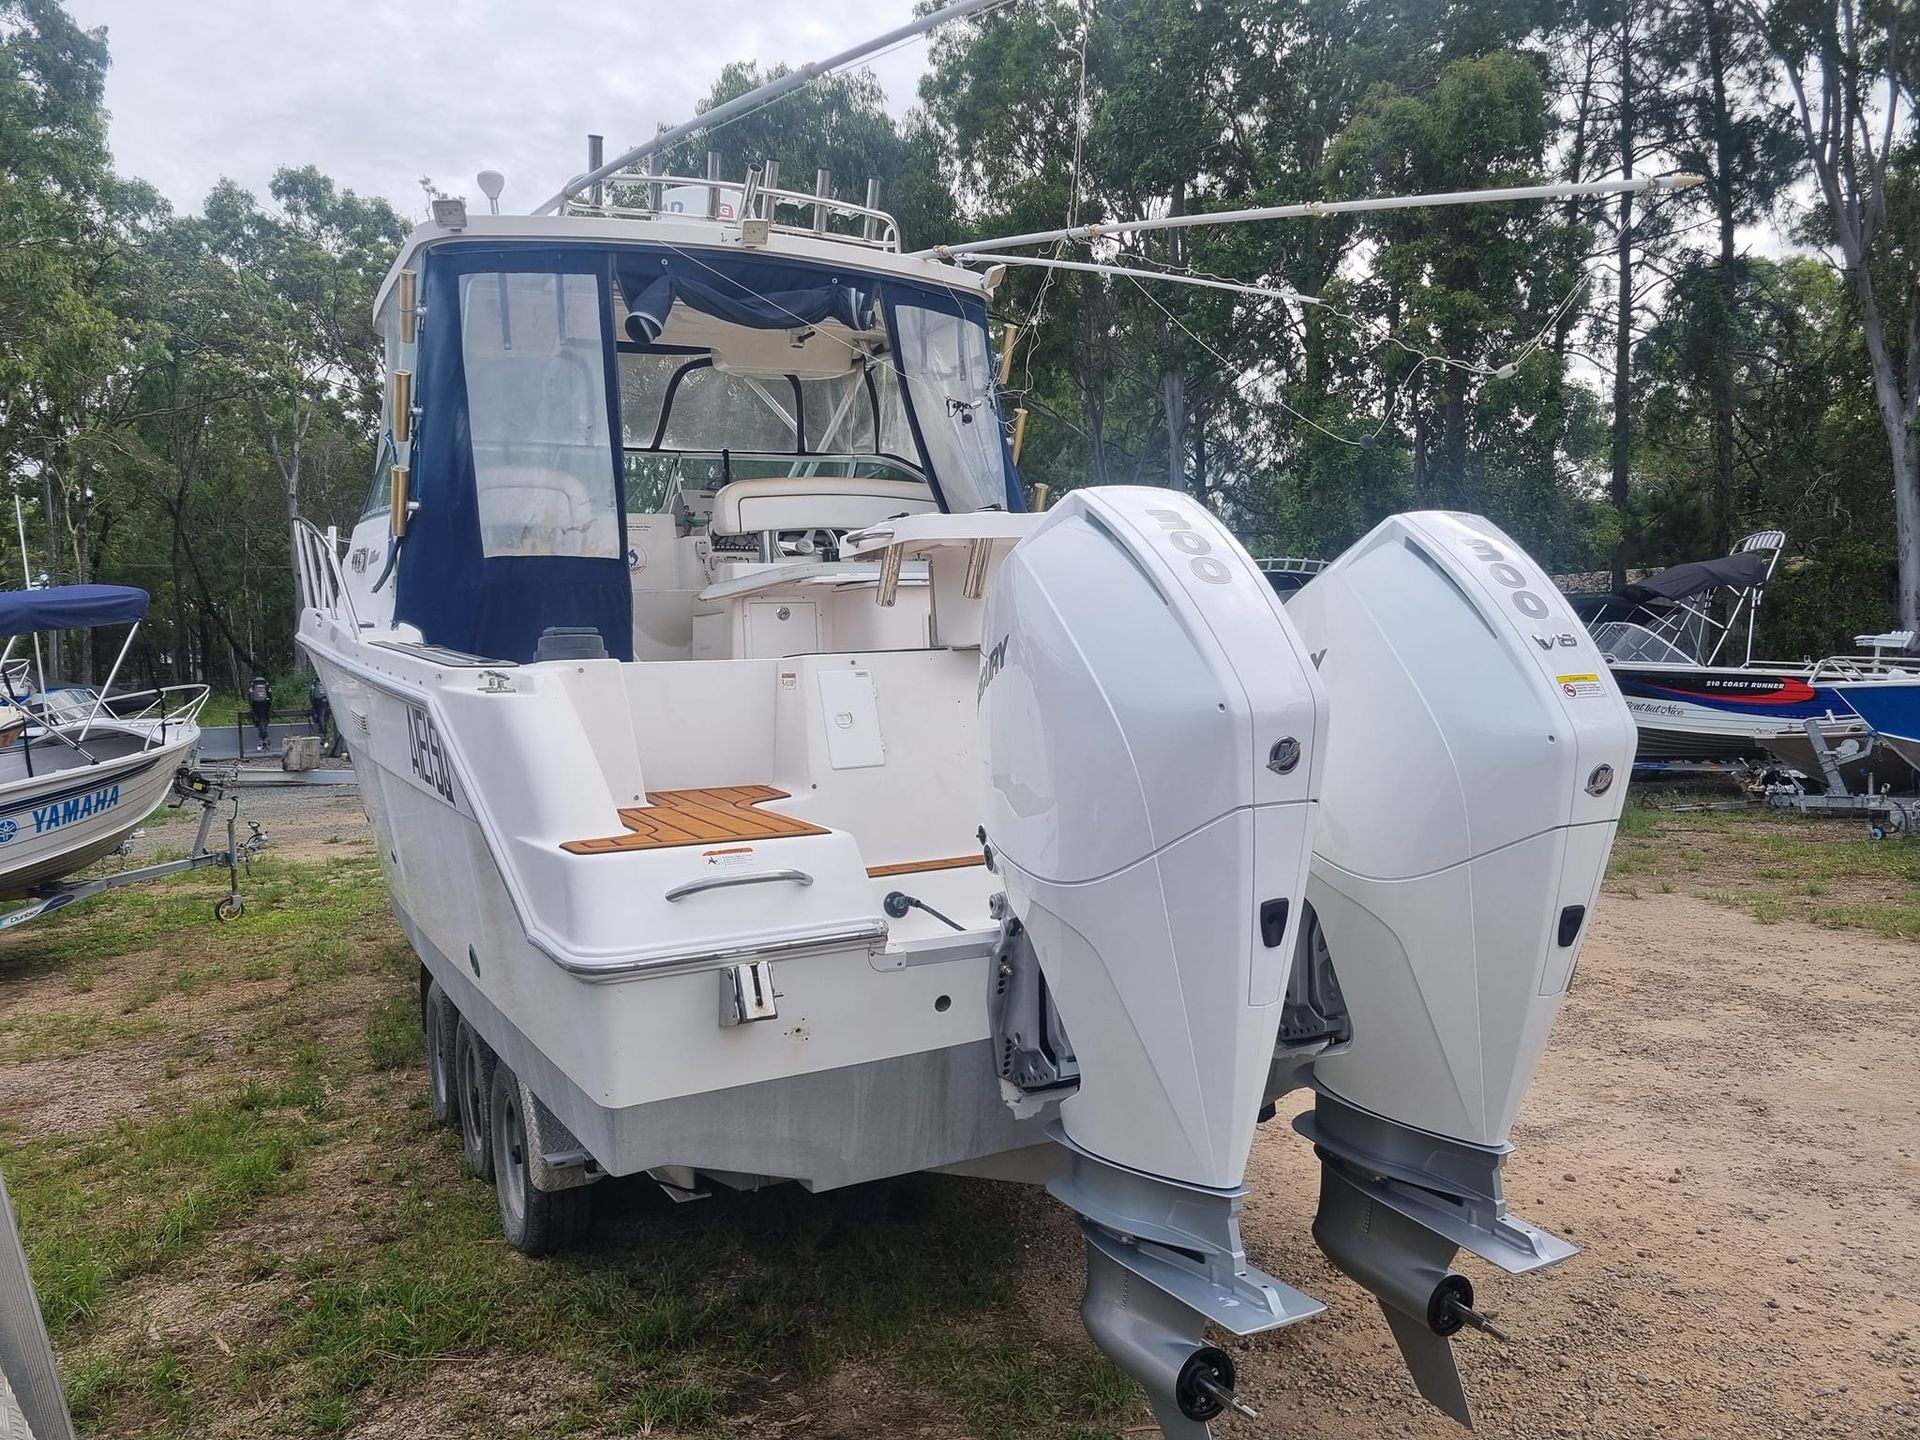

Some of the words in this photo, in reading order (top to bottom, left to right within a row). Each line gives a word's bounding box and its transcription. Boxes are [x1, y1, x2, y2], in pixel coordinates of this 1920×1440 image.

[1144, 509, 1233, 585] 300
[1461, 538, 1550, 620] 300
[1531, 633, 1578, 651] V8
[1722, 681, 1749, 689] COAST
[1750, 682, 1785, 690] RUNNER
[32, 784, 120, 834] YAMAHA
